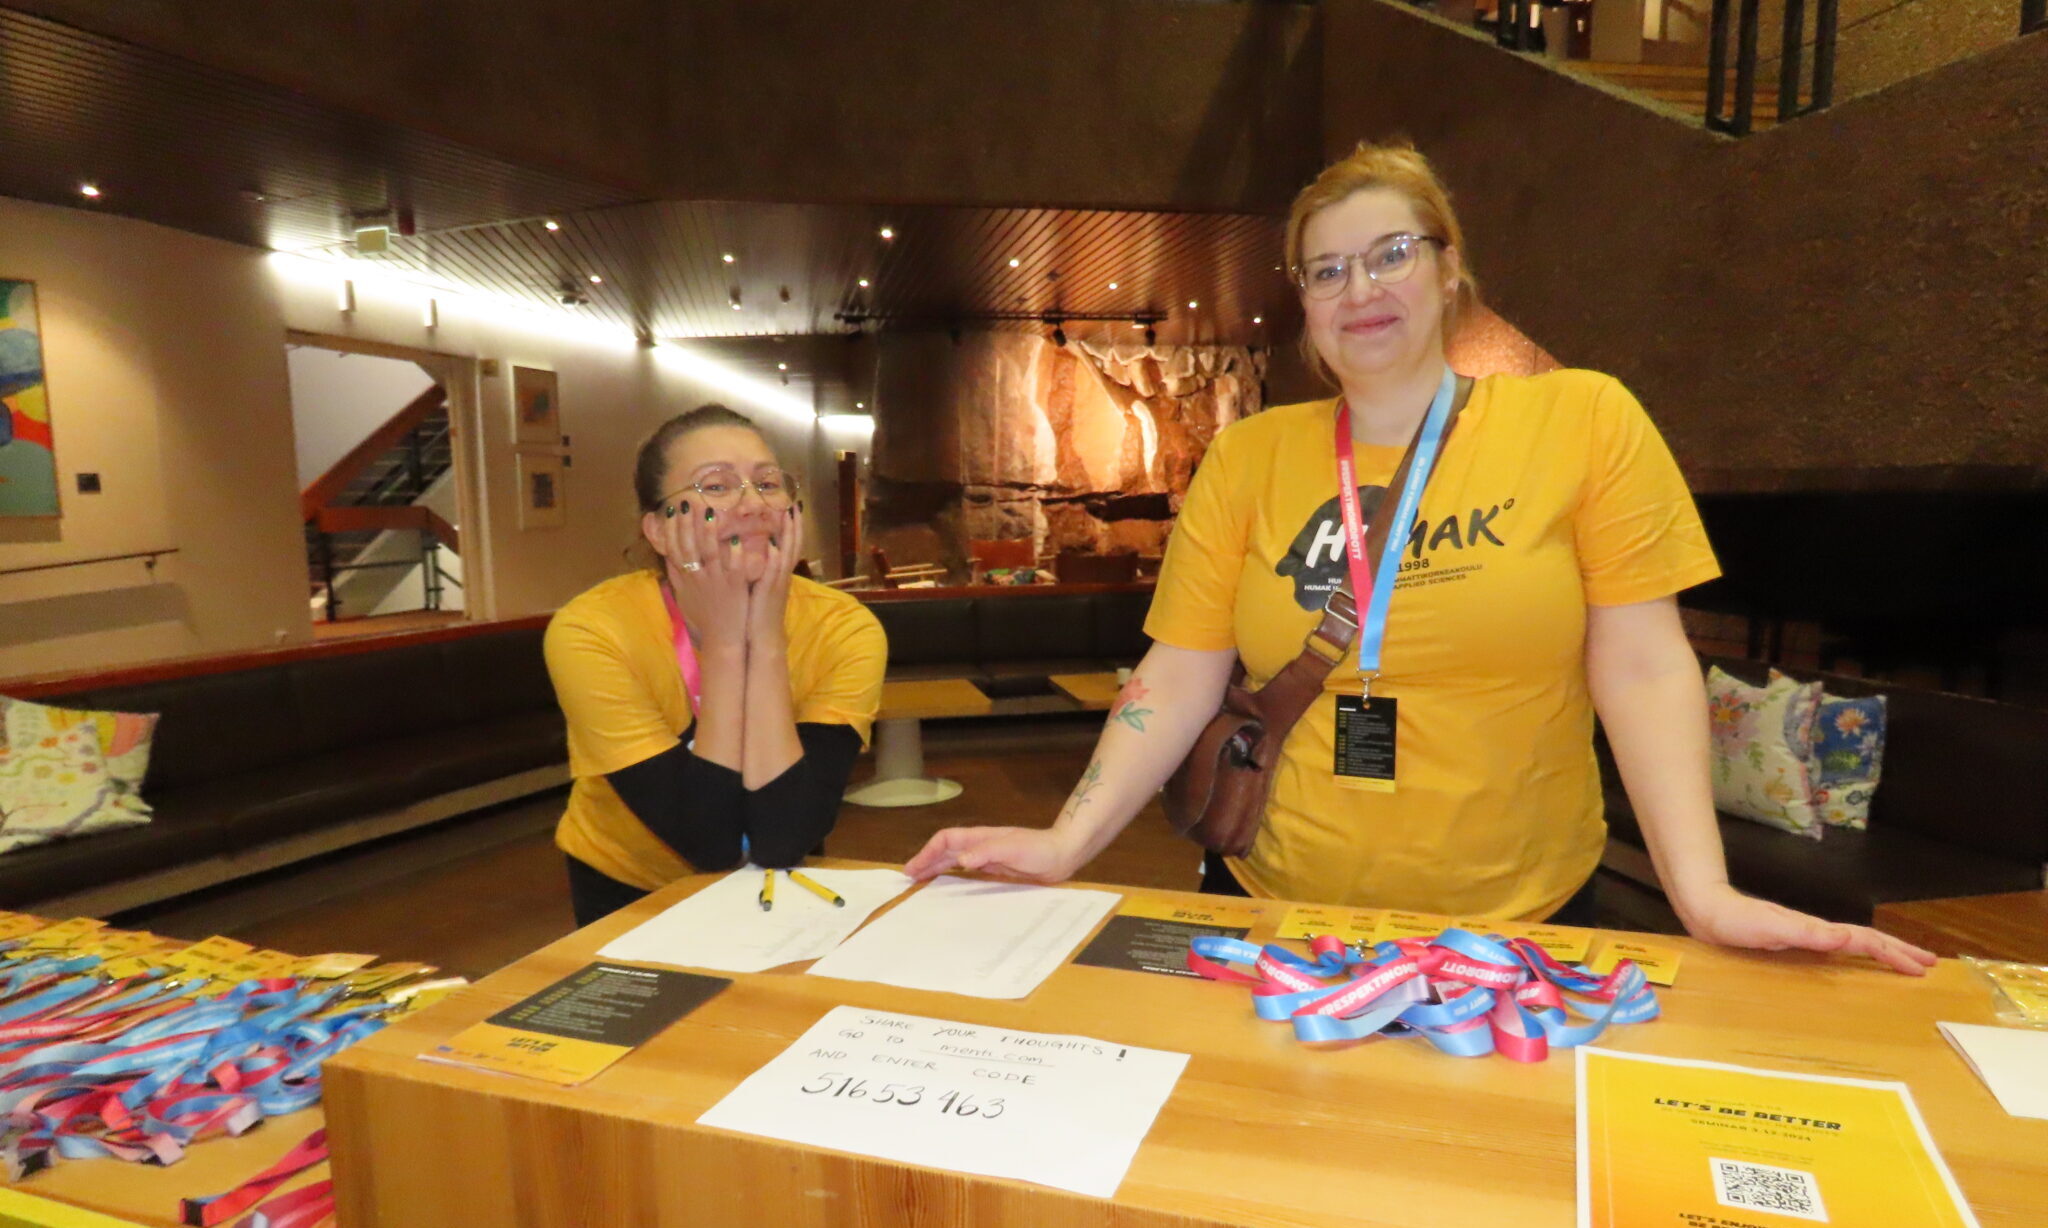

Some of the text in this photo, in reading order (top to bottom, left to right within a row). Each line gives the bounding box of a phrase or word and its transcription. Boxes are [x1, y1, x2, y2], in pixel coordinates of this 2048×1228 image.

[1397, 559, 1430, 573] 1998
[1428, 574, 1467, 585] SCIENCES
[1440, 961, 1513, 984] OMIDROTT
[838, 1029, 864, 1039] GO
[886, 1034, 904, 1044] TO
[860, 1015, 915, 1030] SHARE
[933, 1026, 978, 1038] YOUR
[1000, 1036, 1104, 1056] THOUGHTS
[809, 1048, 1038, 1085] AND ENTER CODE
[1654, 1097, 1711, 1112] LET'S
[1718, 1107, 1747, 1117] BE
[1753, 1111, 1842, 1131] BETTER
